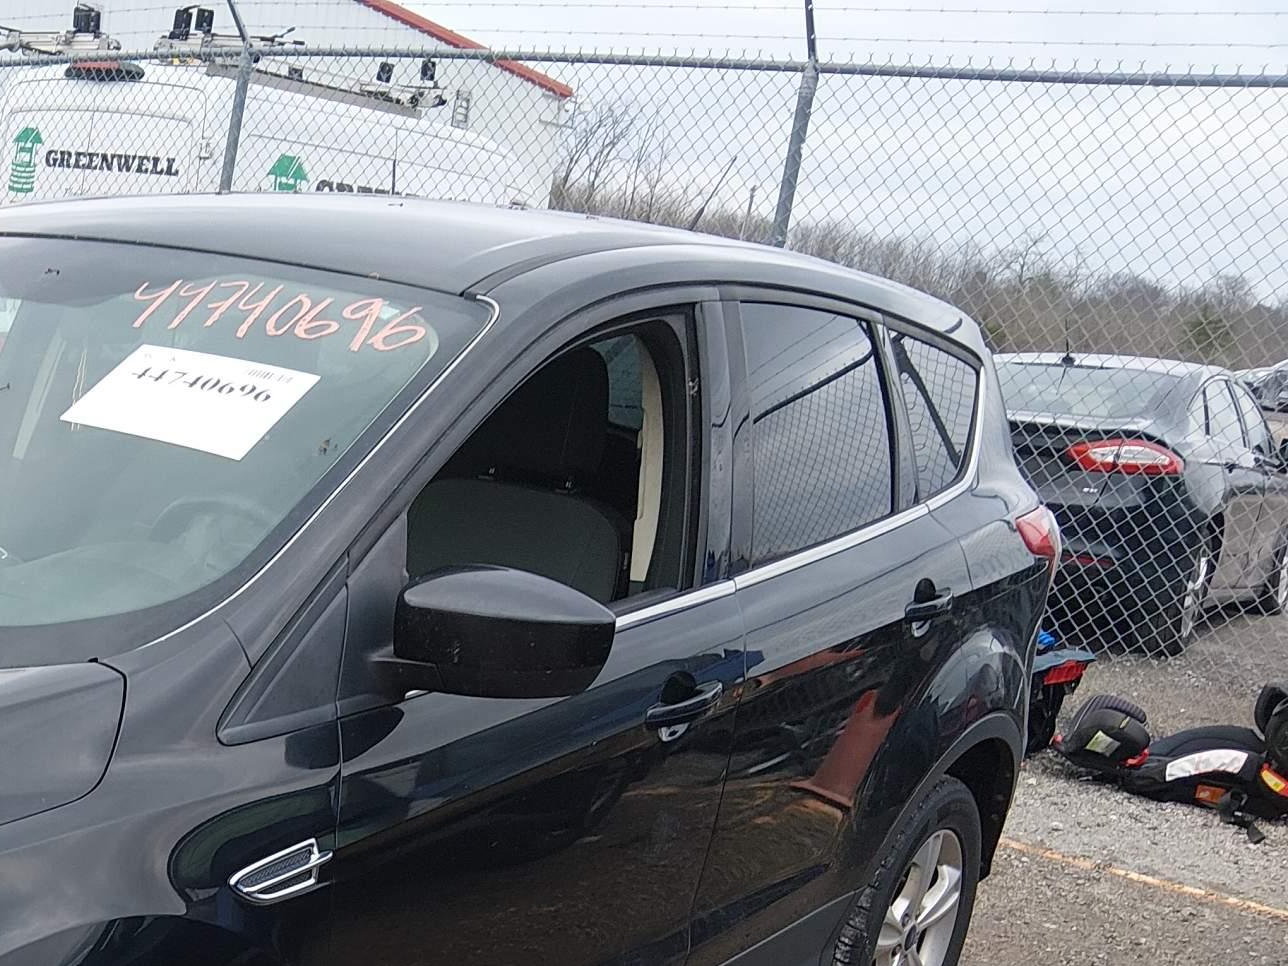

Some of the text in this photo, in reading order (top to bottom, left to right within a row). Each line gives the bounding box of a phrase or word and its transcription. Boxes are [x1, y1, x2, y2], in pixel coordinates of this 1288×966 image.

[44, 149, 180, 177] GREENWELL
[132, 279, 426, 352] 44740696
[131, 366, 272, 403] 44740696
